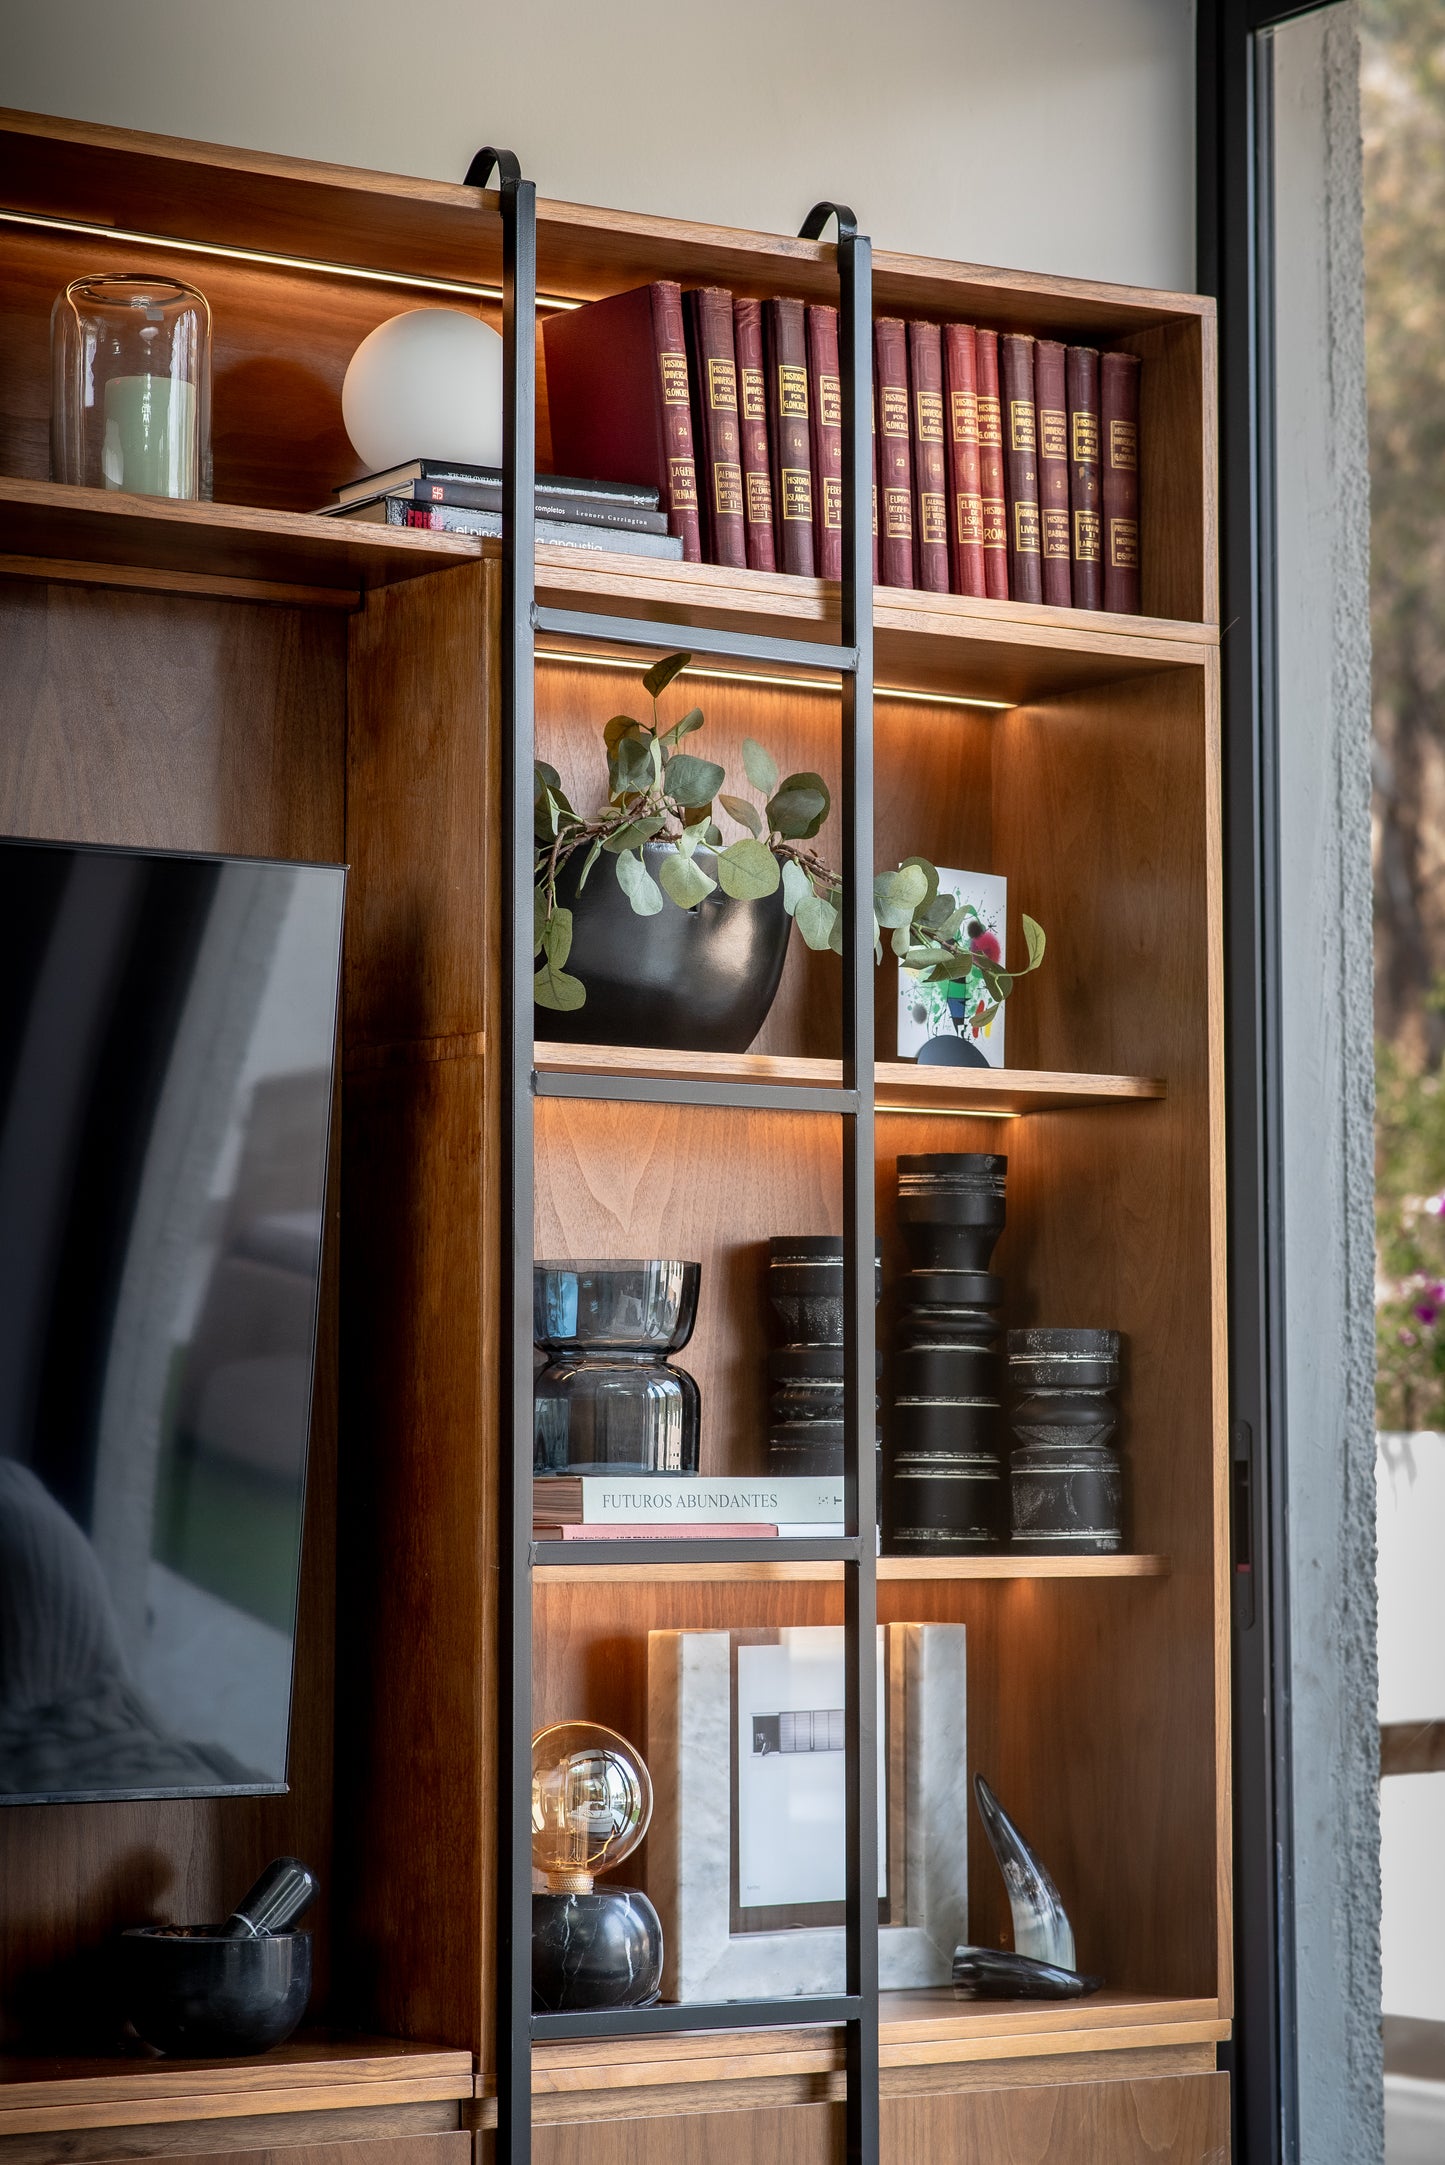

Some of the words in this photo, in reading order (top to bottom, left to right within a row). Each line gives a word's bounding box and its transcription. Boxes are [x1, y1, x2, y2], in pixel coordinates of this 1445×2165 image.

[663, 371, 687, 380] UNIVERSA
[713, 376, 736, 386] UNIVERSA
[783, 382, 807, 393] UNIVERSA
[884, 403, 908, 414] UNIVERSA
[979, 404, 1000, 413] HISTOR
[681, 479, 691, 487] DE
[535, 505, 565, 515] completos
[576, 510, 604, 520] Leonora
[608, 514, 648, 526] Carrington
[984, 506, 1005, 516] HISTOR
[1047, 515, 1068, 525] HISTOR
[603, 1494, 672, 1508] FUTUROS
[676, 1494, 777, 1508] ABUNDANTES
